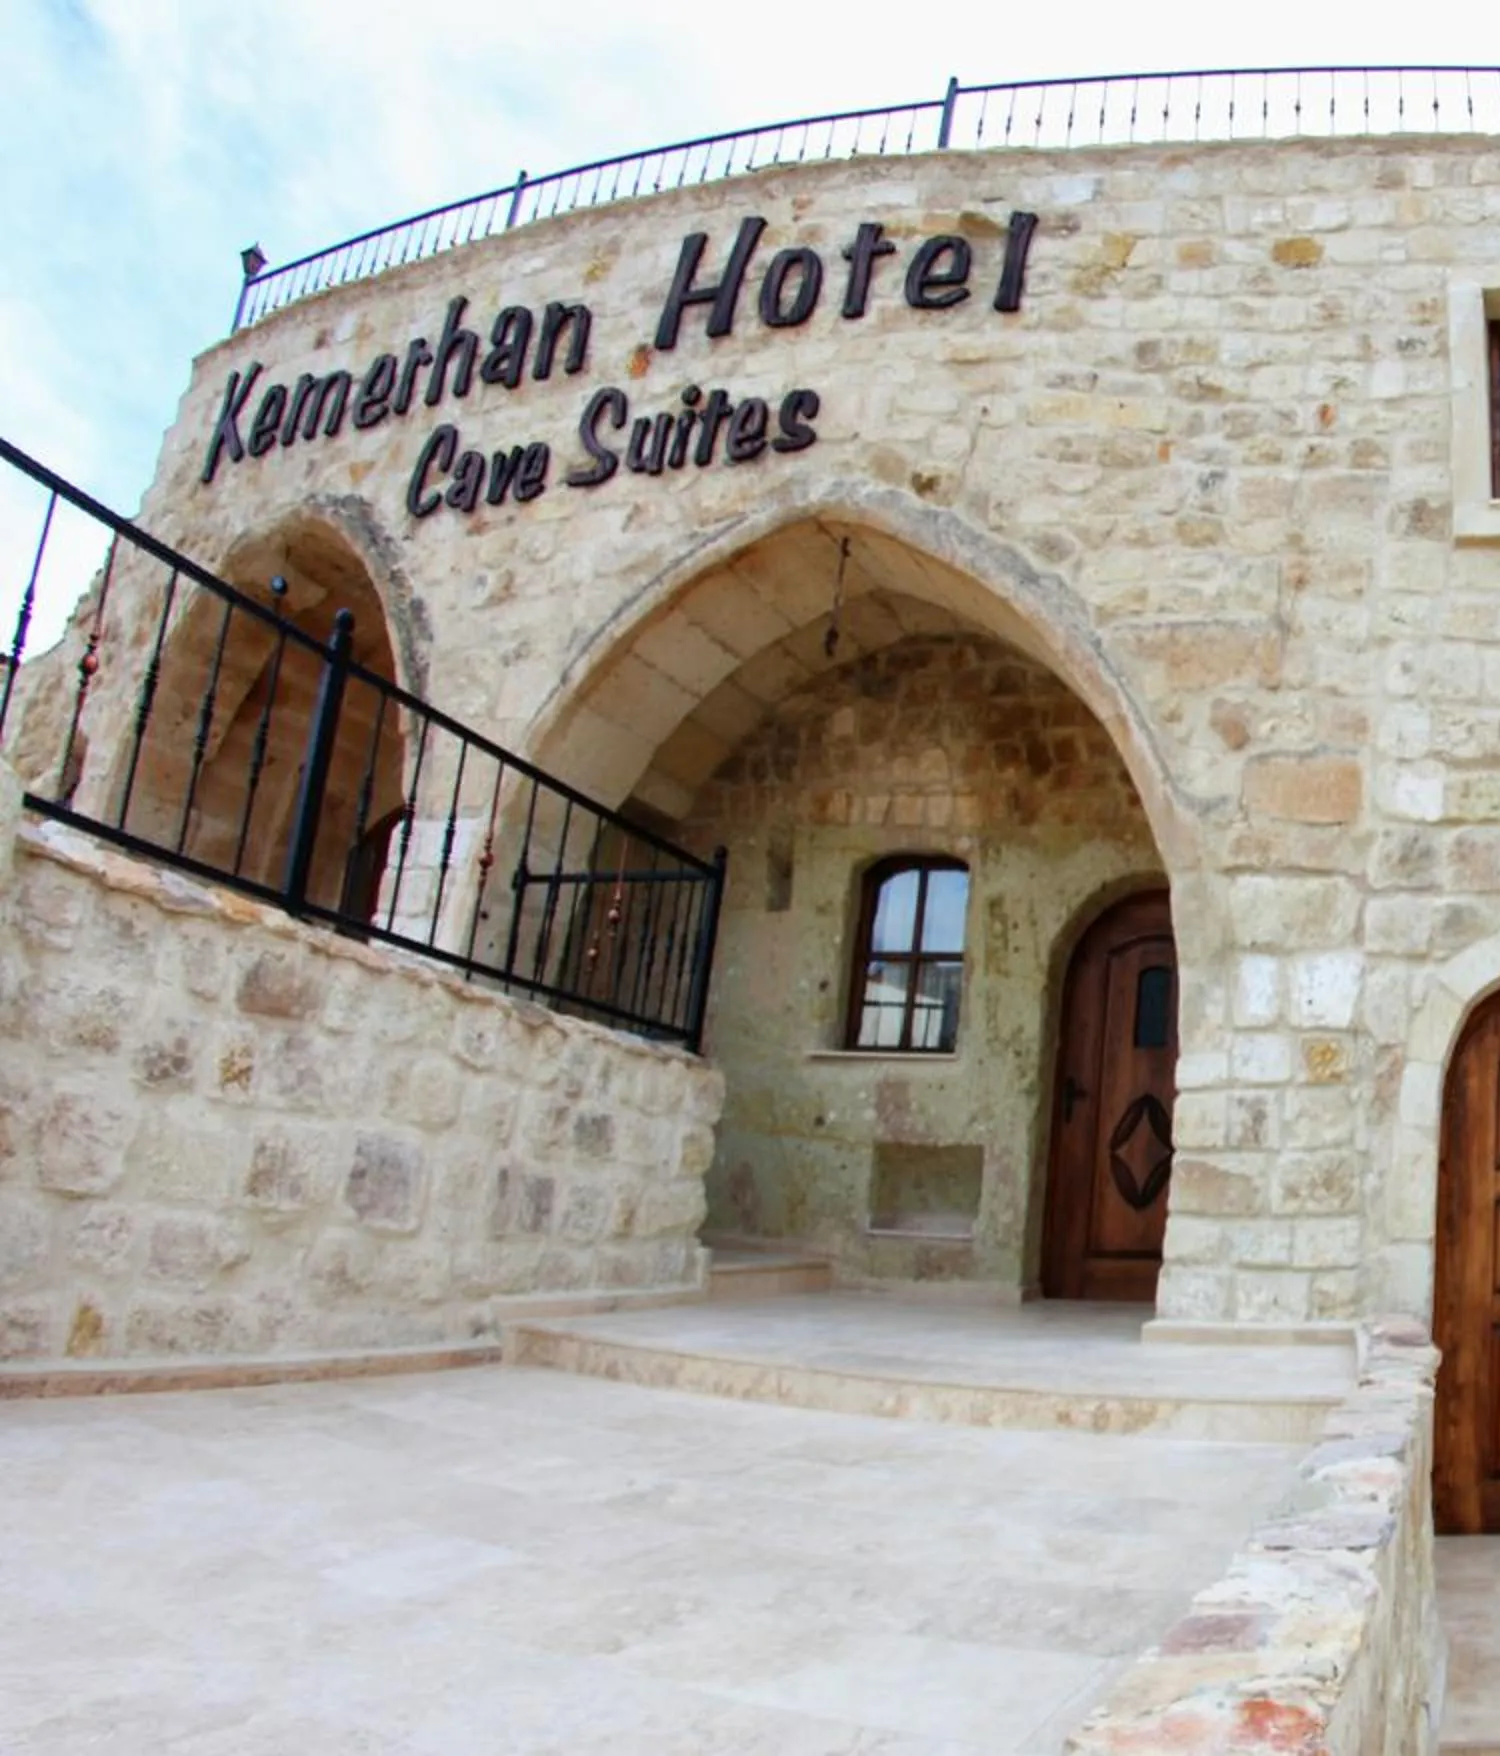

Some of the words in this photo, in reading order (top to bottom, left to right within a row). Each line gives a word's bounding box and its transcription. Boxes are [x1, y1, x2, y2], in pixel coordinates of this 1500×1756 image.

[200, 295, 593, 484] Kemerhan
[653, 211, 1039, 351] Hotel
[405, 422, 550, 518] Cave
[566, 384, 820, 489] Suites
